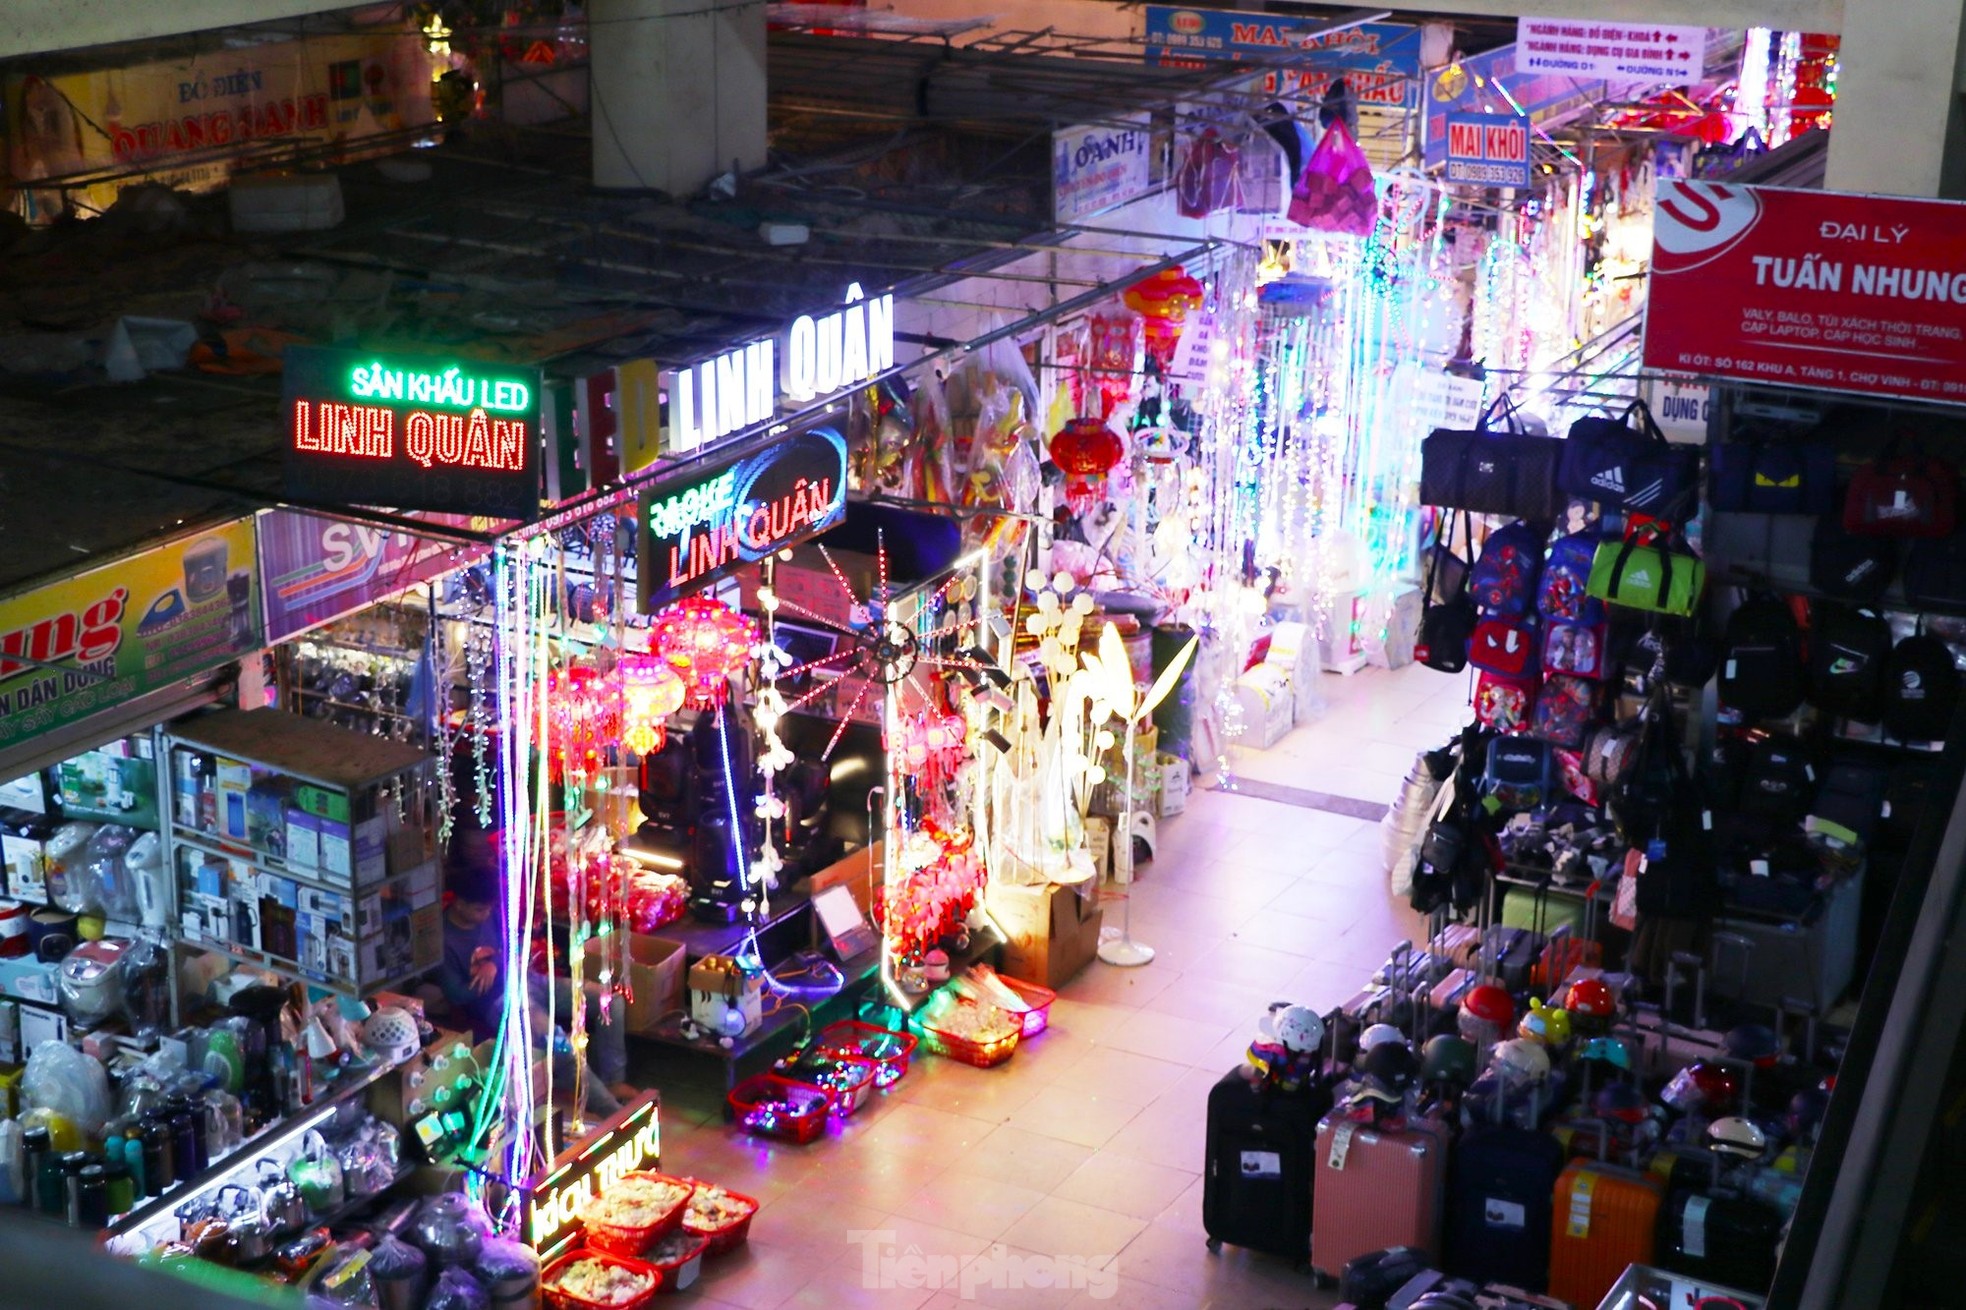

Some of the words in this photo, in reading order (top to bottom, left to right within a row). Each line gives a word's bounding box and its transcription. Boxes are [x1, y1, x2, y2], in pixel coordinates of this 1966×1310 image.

[1450, 124, 1482, 159] MAI
[1485, 119, 1526, 162] KHÔI
[1819, 221, 1866, 244] ĐẠI
[1873, 223, 1909, 244] LÝ
[1753, 253, 1842, 292] TUẤN
[1852, 265, 1966, 304] NHUNG
[1842, 315, 1877, 331] XÁCH
[668, 338, 774, 454] LINH
[786, 281, 895, 402] QUÂN
[1757, 361, 1784, 375] KHU
[1881, 374, 1912, 388] VINH
[408, 367, 475, 407] KHẤU
[480, 380, 530, 411] LED
[1663, 396, 1698, 422] DỤNG
[296, 400, 393, 458] LINH
[406, 407, 525, 471] QUÂN
[1590, 477, 1626, 494] adidas
[670, 519, 740, 589] LINH
[749, 476, 830, 550] QUÂN
[17, 676, 59, 712] DÂN
